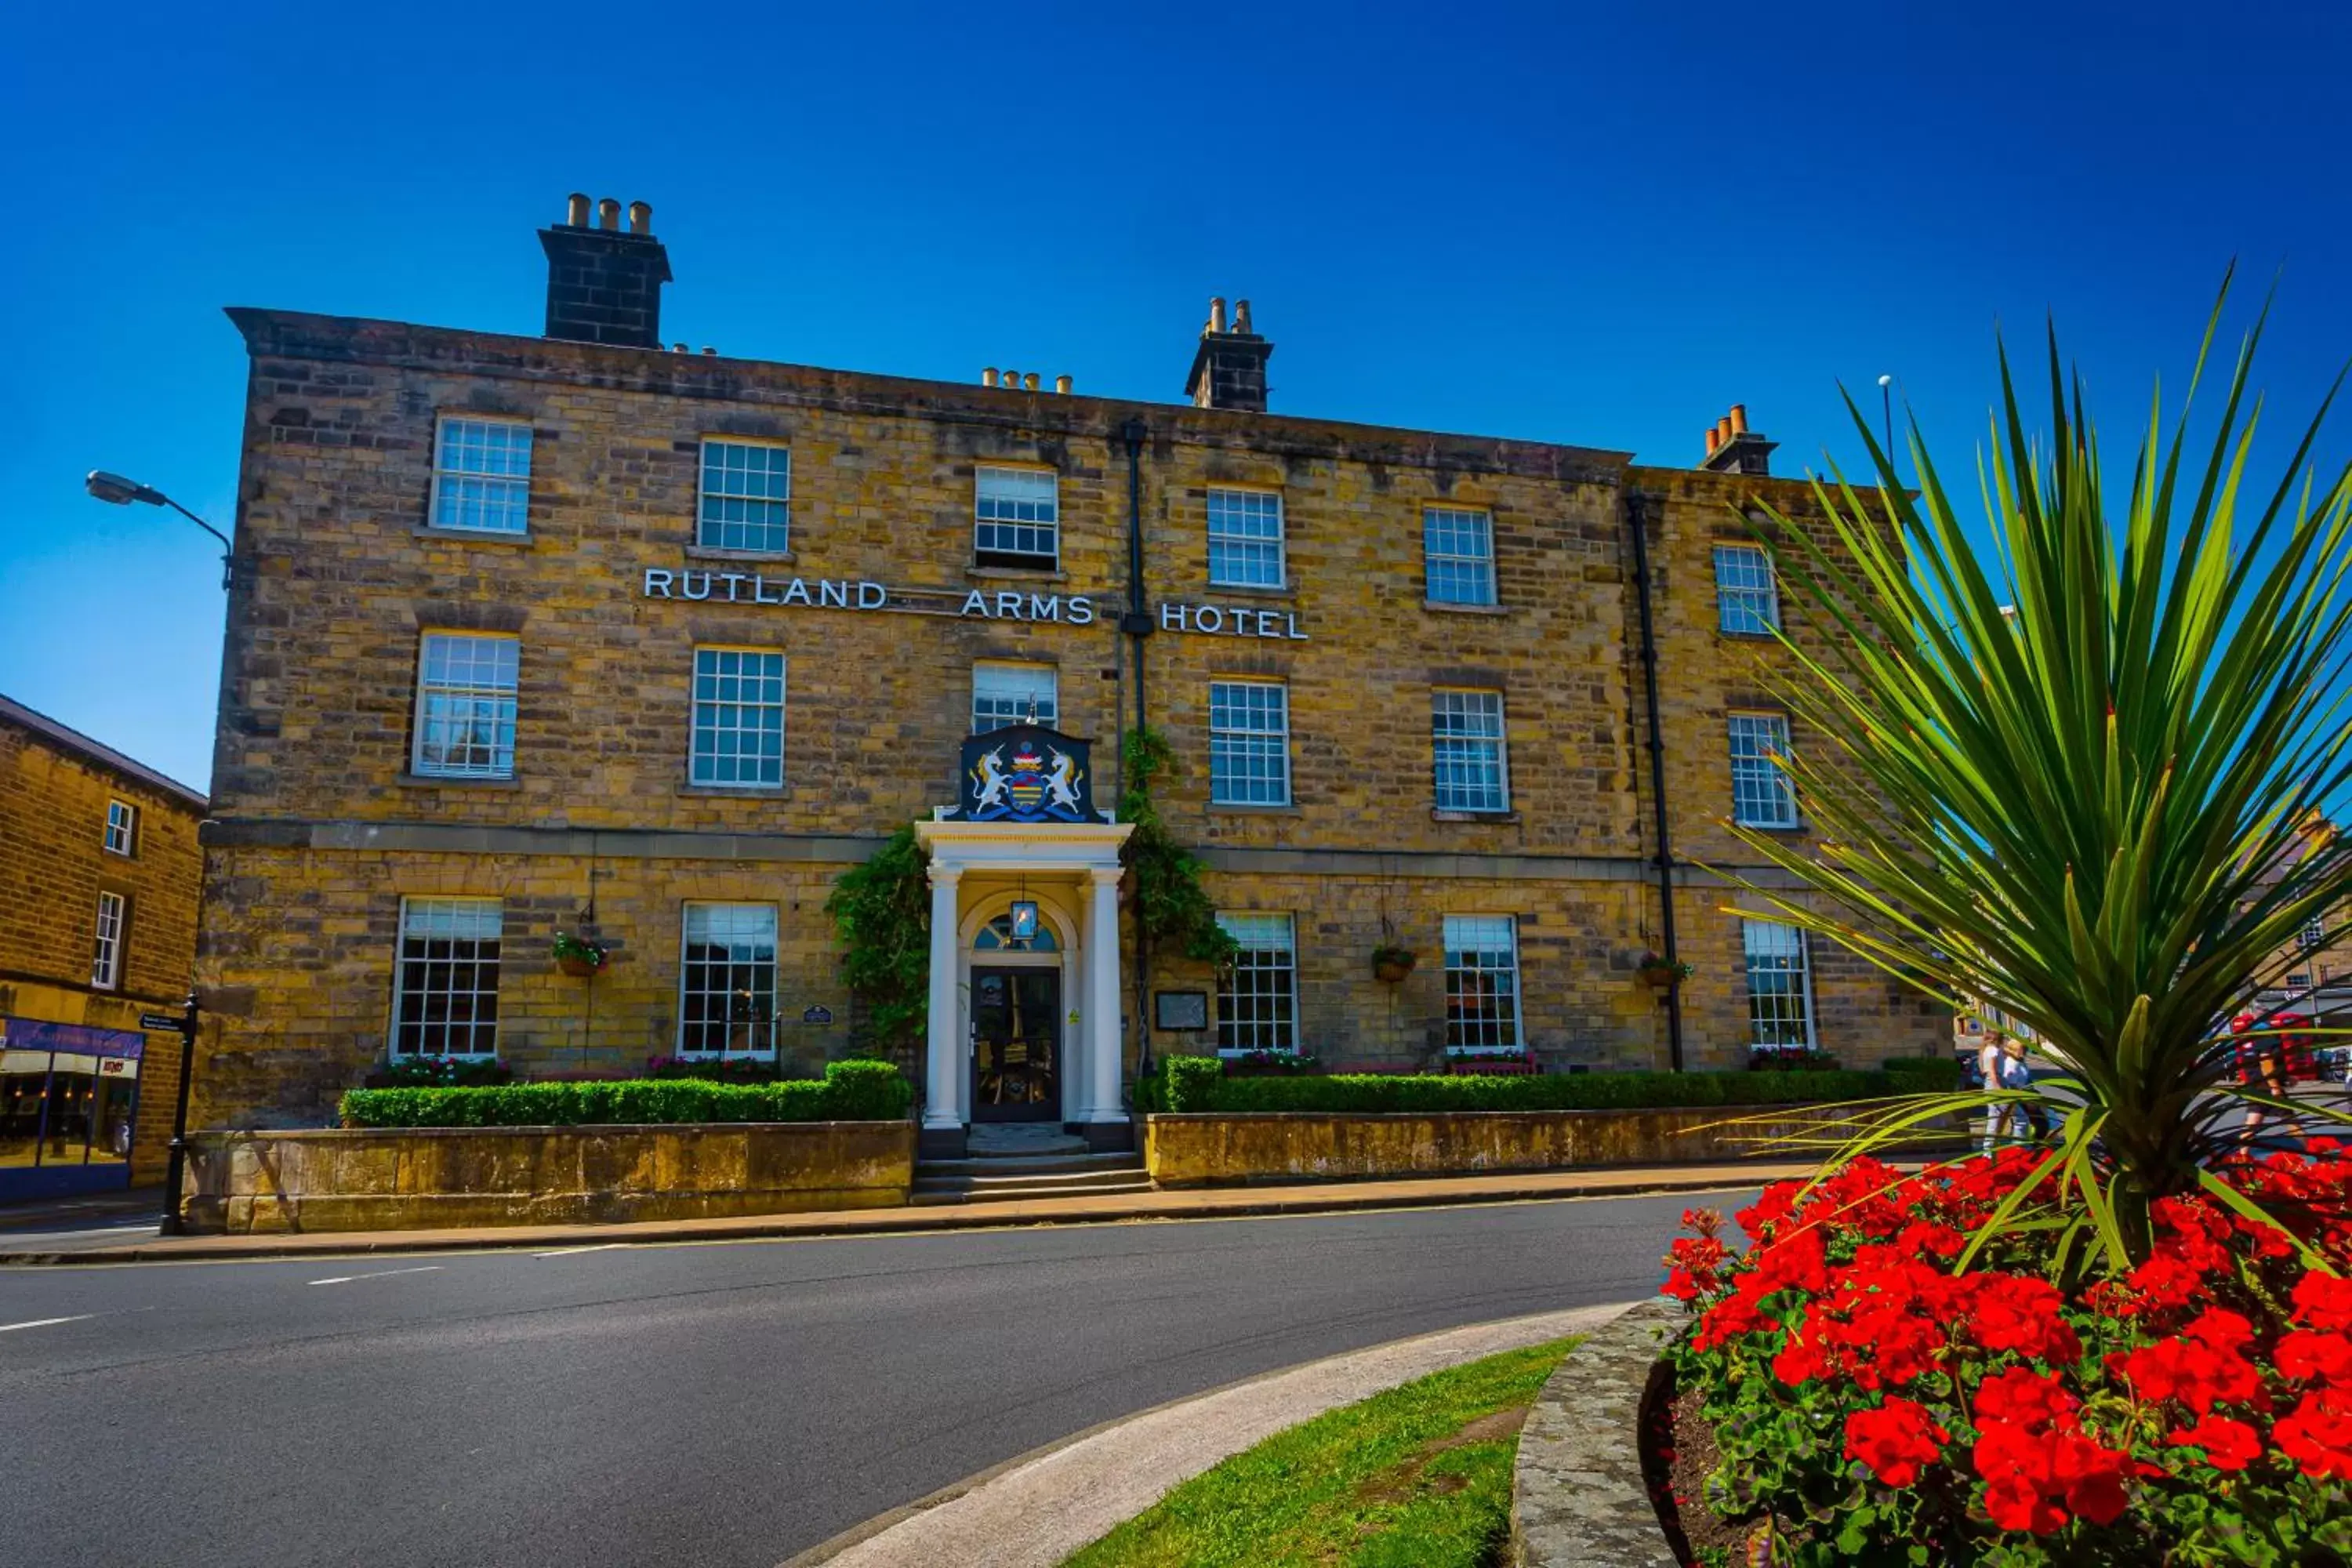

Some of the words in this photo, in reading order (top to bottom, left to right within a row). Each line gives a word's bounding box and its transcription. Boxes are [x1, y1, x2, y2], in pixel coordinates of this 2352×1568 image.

[644, 568, 887, 609] RUTLAND
[961, 589, 1093, 624] ARMS
[1161, 603, 1309, 640] HOTEL
